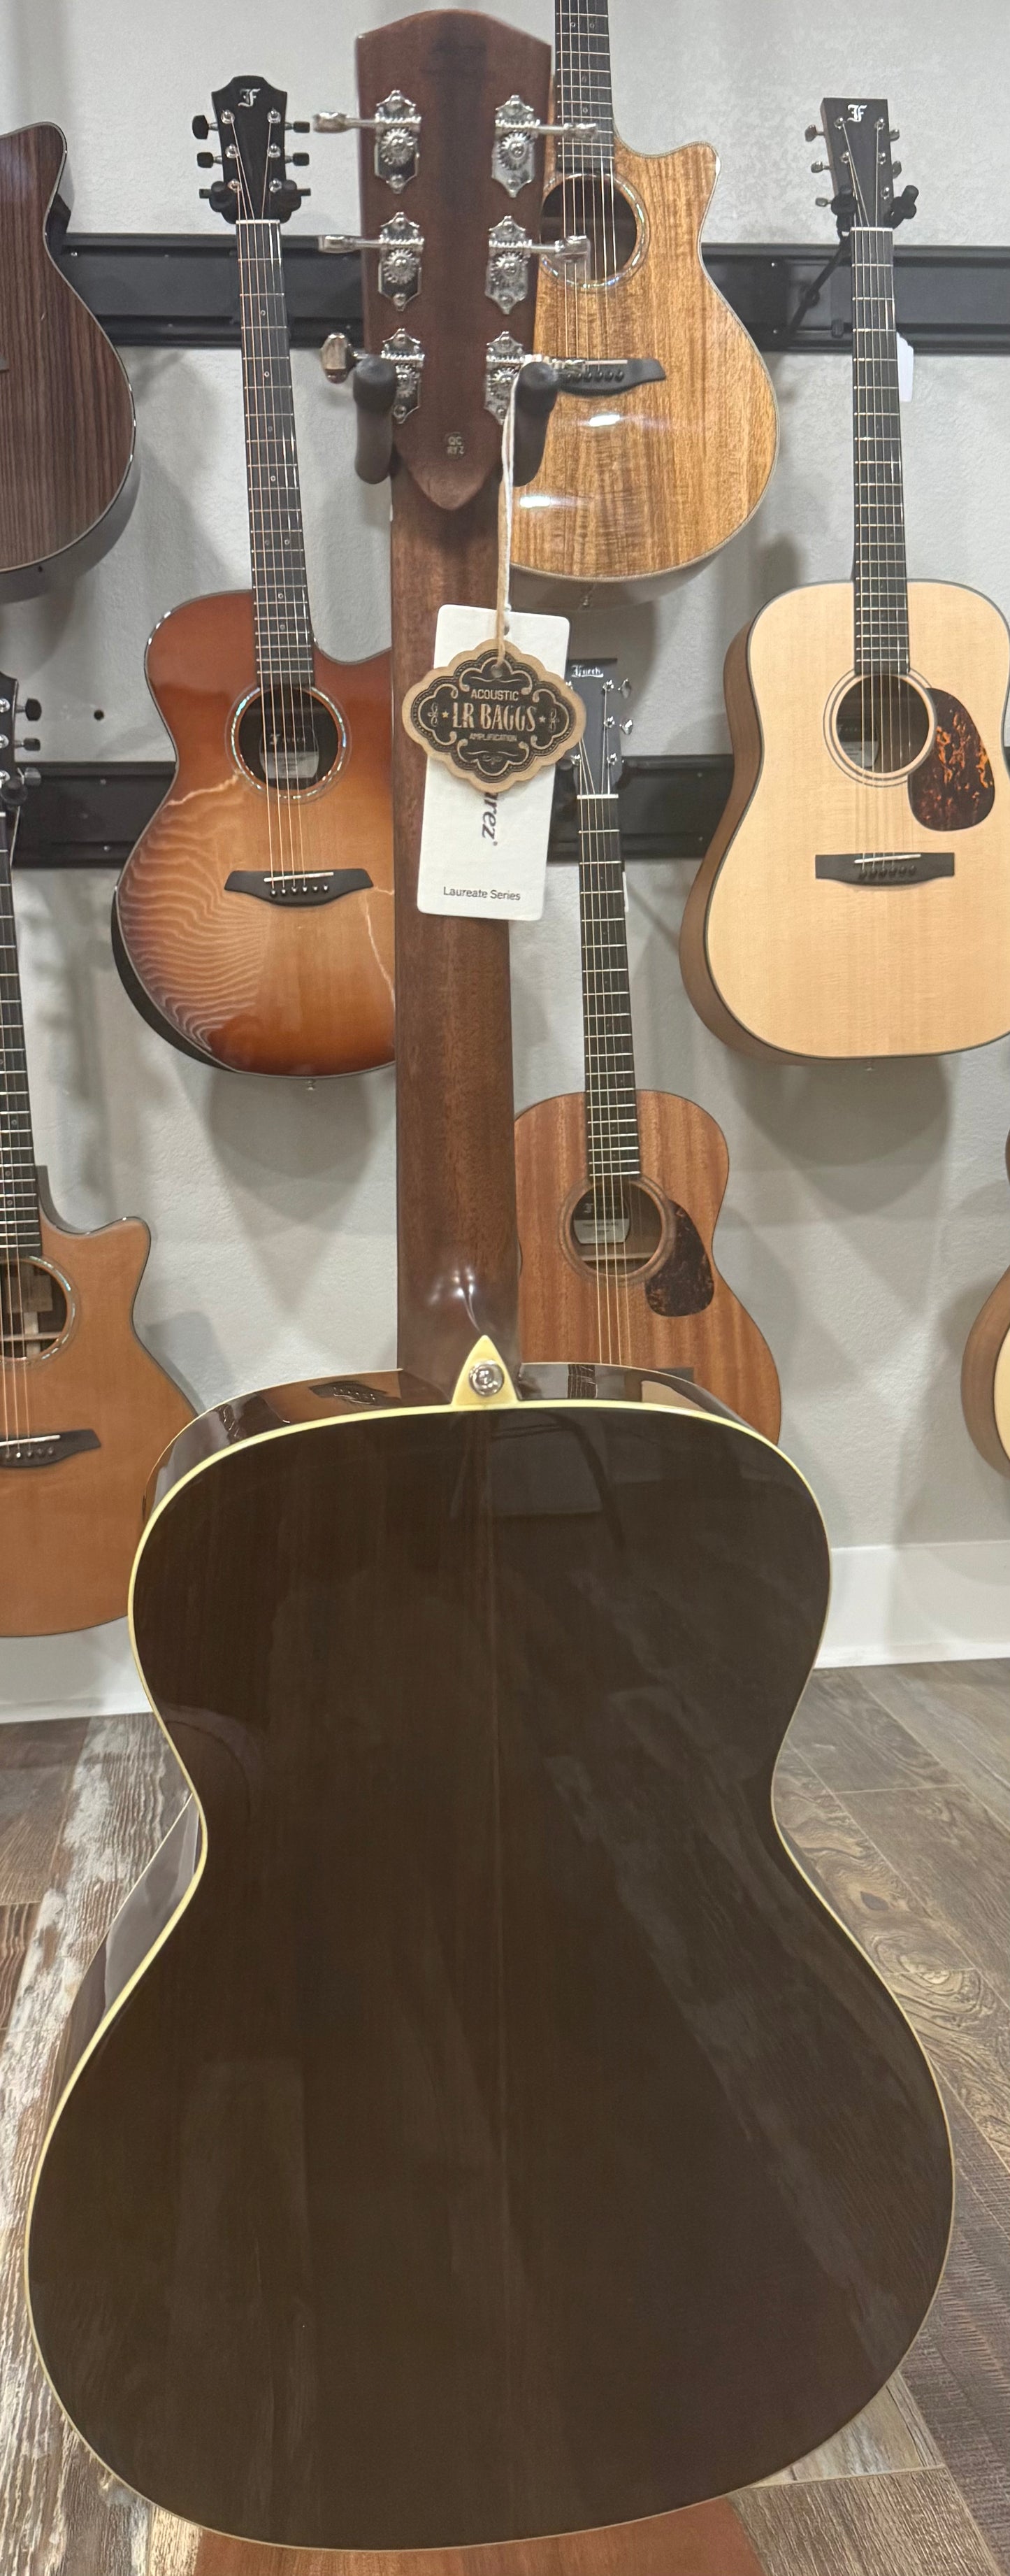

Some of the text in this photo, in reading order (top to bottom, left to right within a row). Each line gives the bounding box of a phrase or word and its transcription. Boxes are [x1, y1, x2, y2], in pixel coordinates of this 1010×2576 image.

[470, 688, 519, 701] ACOUSTIC
[452, 702, 538, 732] LR BAGGS
[469, 733, 517, 742] AMPLIFICATION
[443, 886, 521, 901] Laureate Series
